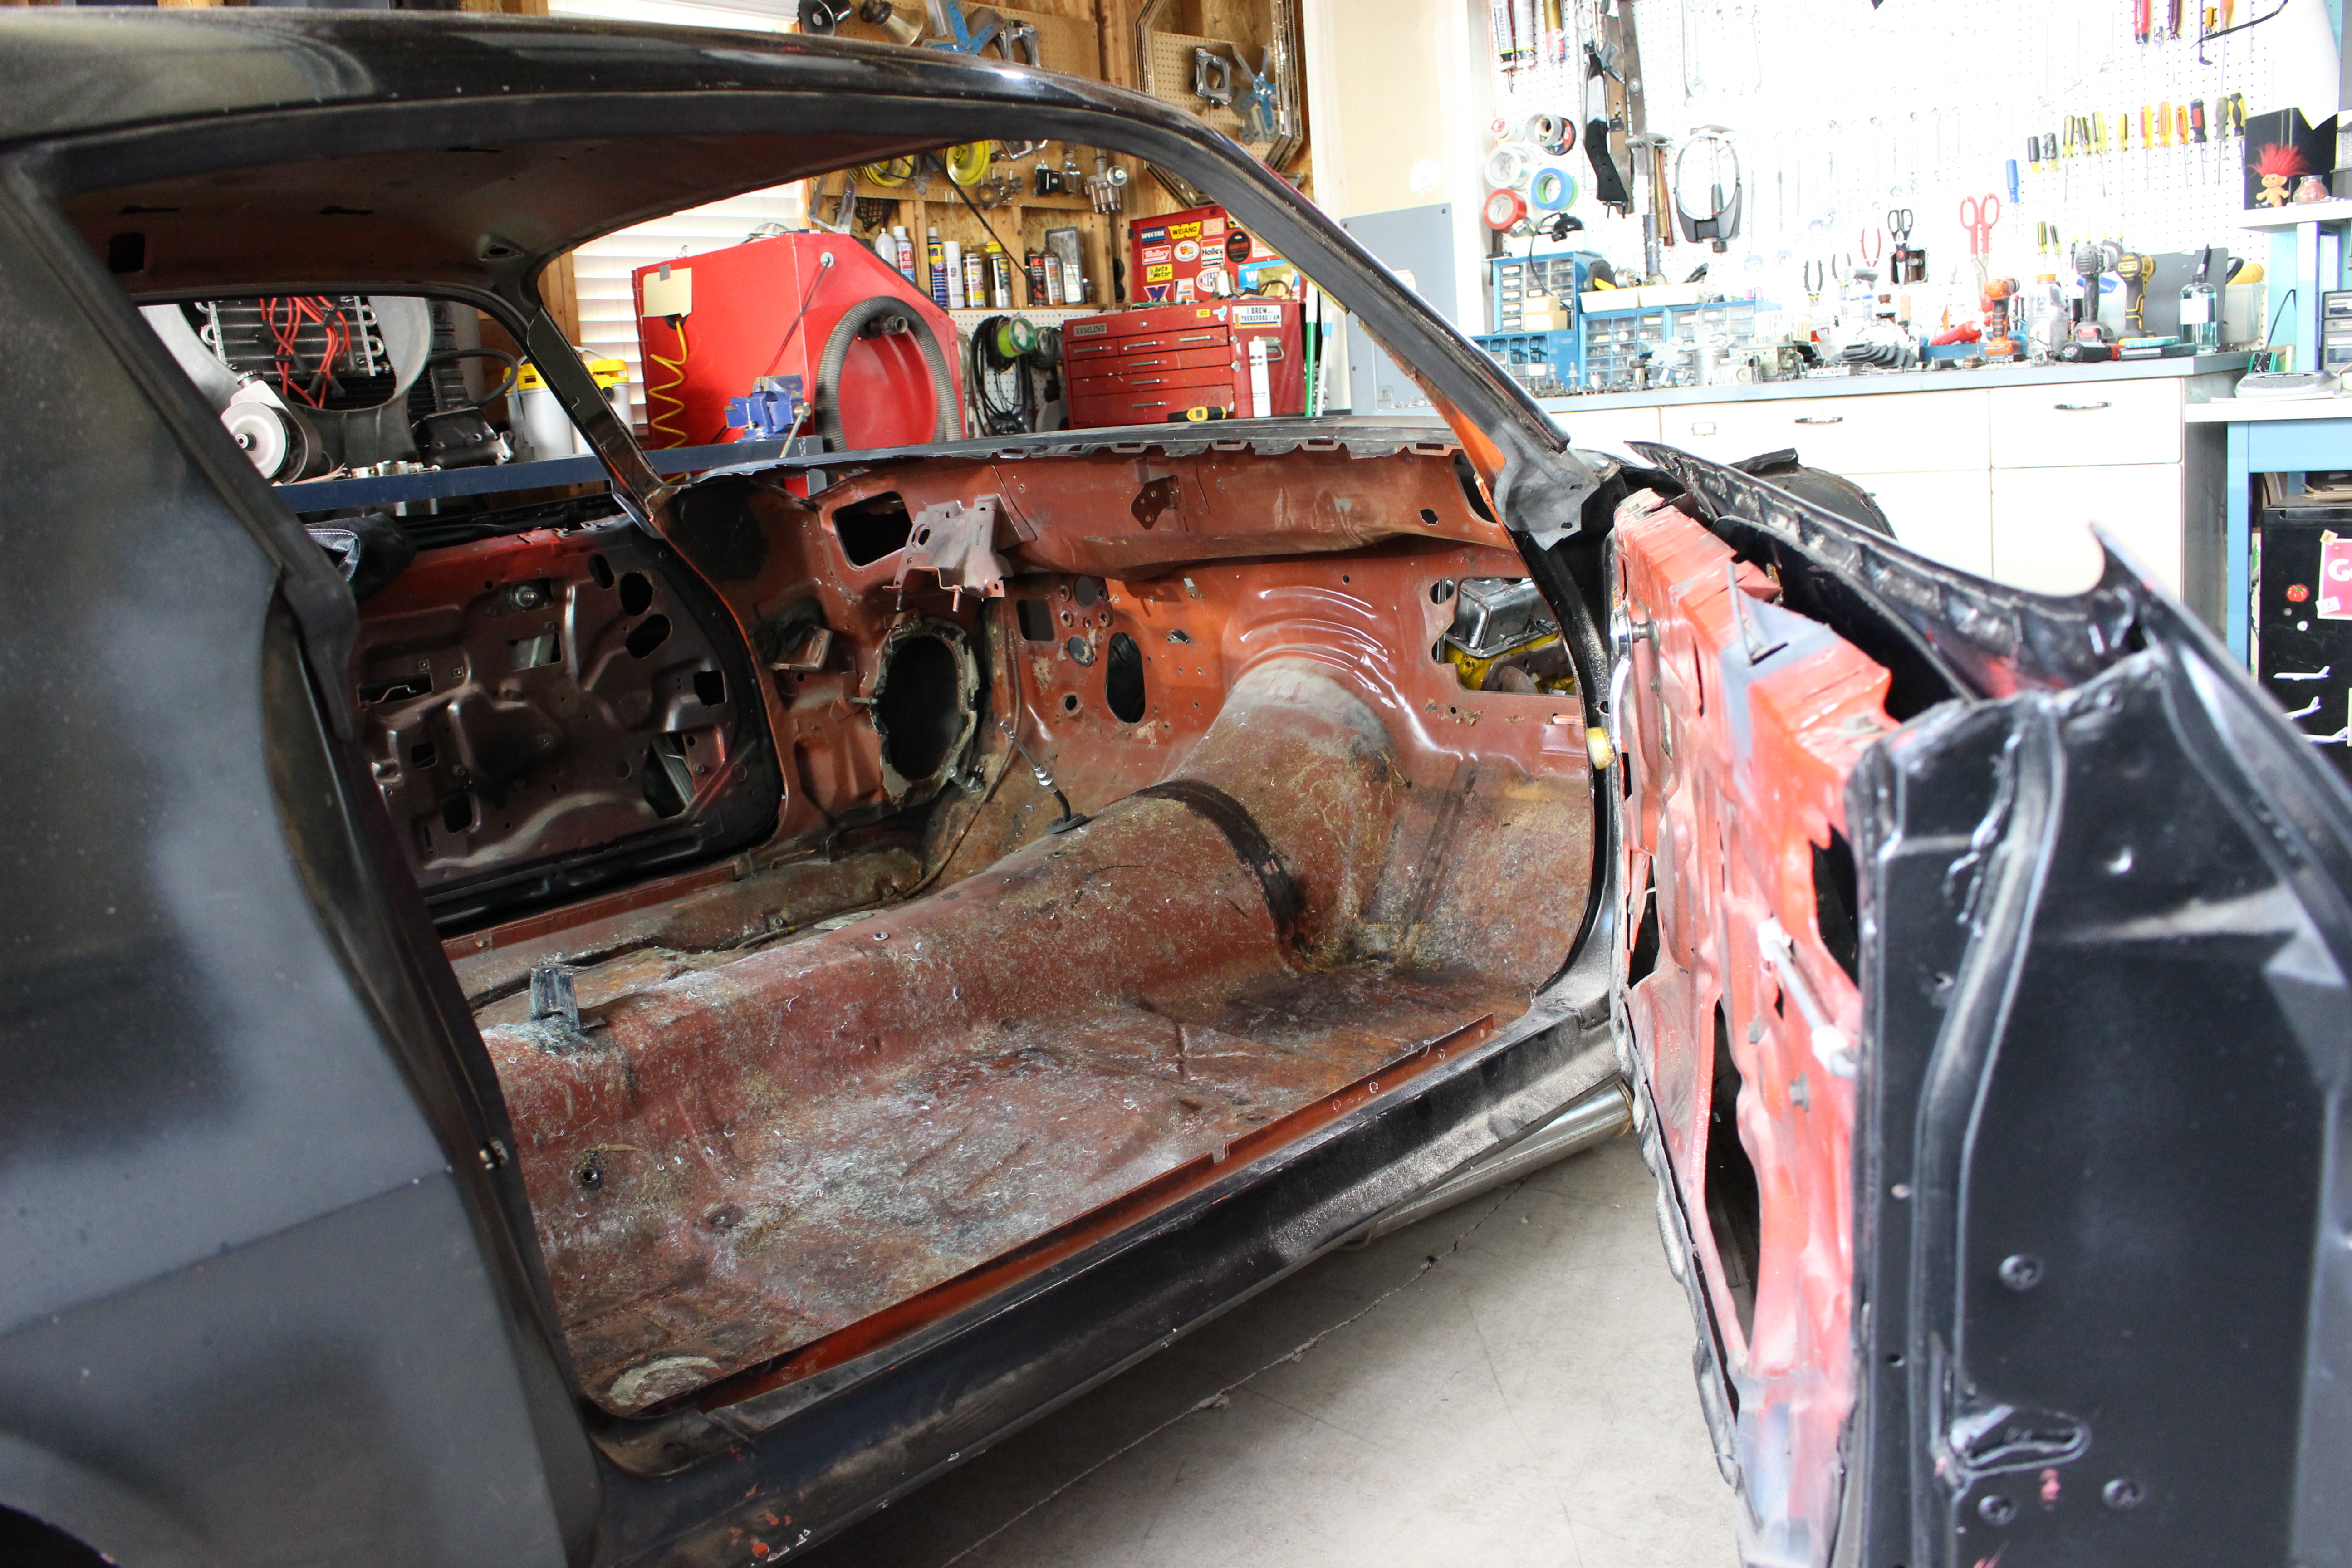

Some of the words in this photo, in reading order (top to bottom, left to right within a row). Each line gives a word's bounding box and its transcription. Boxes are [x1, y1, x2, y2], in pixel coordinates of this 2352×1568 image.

[1497, 7, 1506, 37] DYNAFLEX
[1173, 226, 1197, 235] WEIAND
[1202, 247, 1223, 256] Holley
[1201, 272, 1218, 287] NH
[2328, 558, 2352, 582] G
